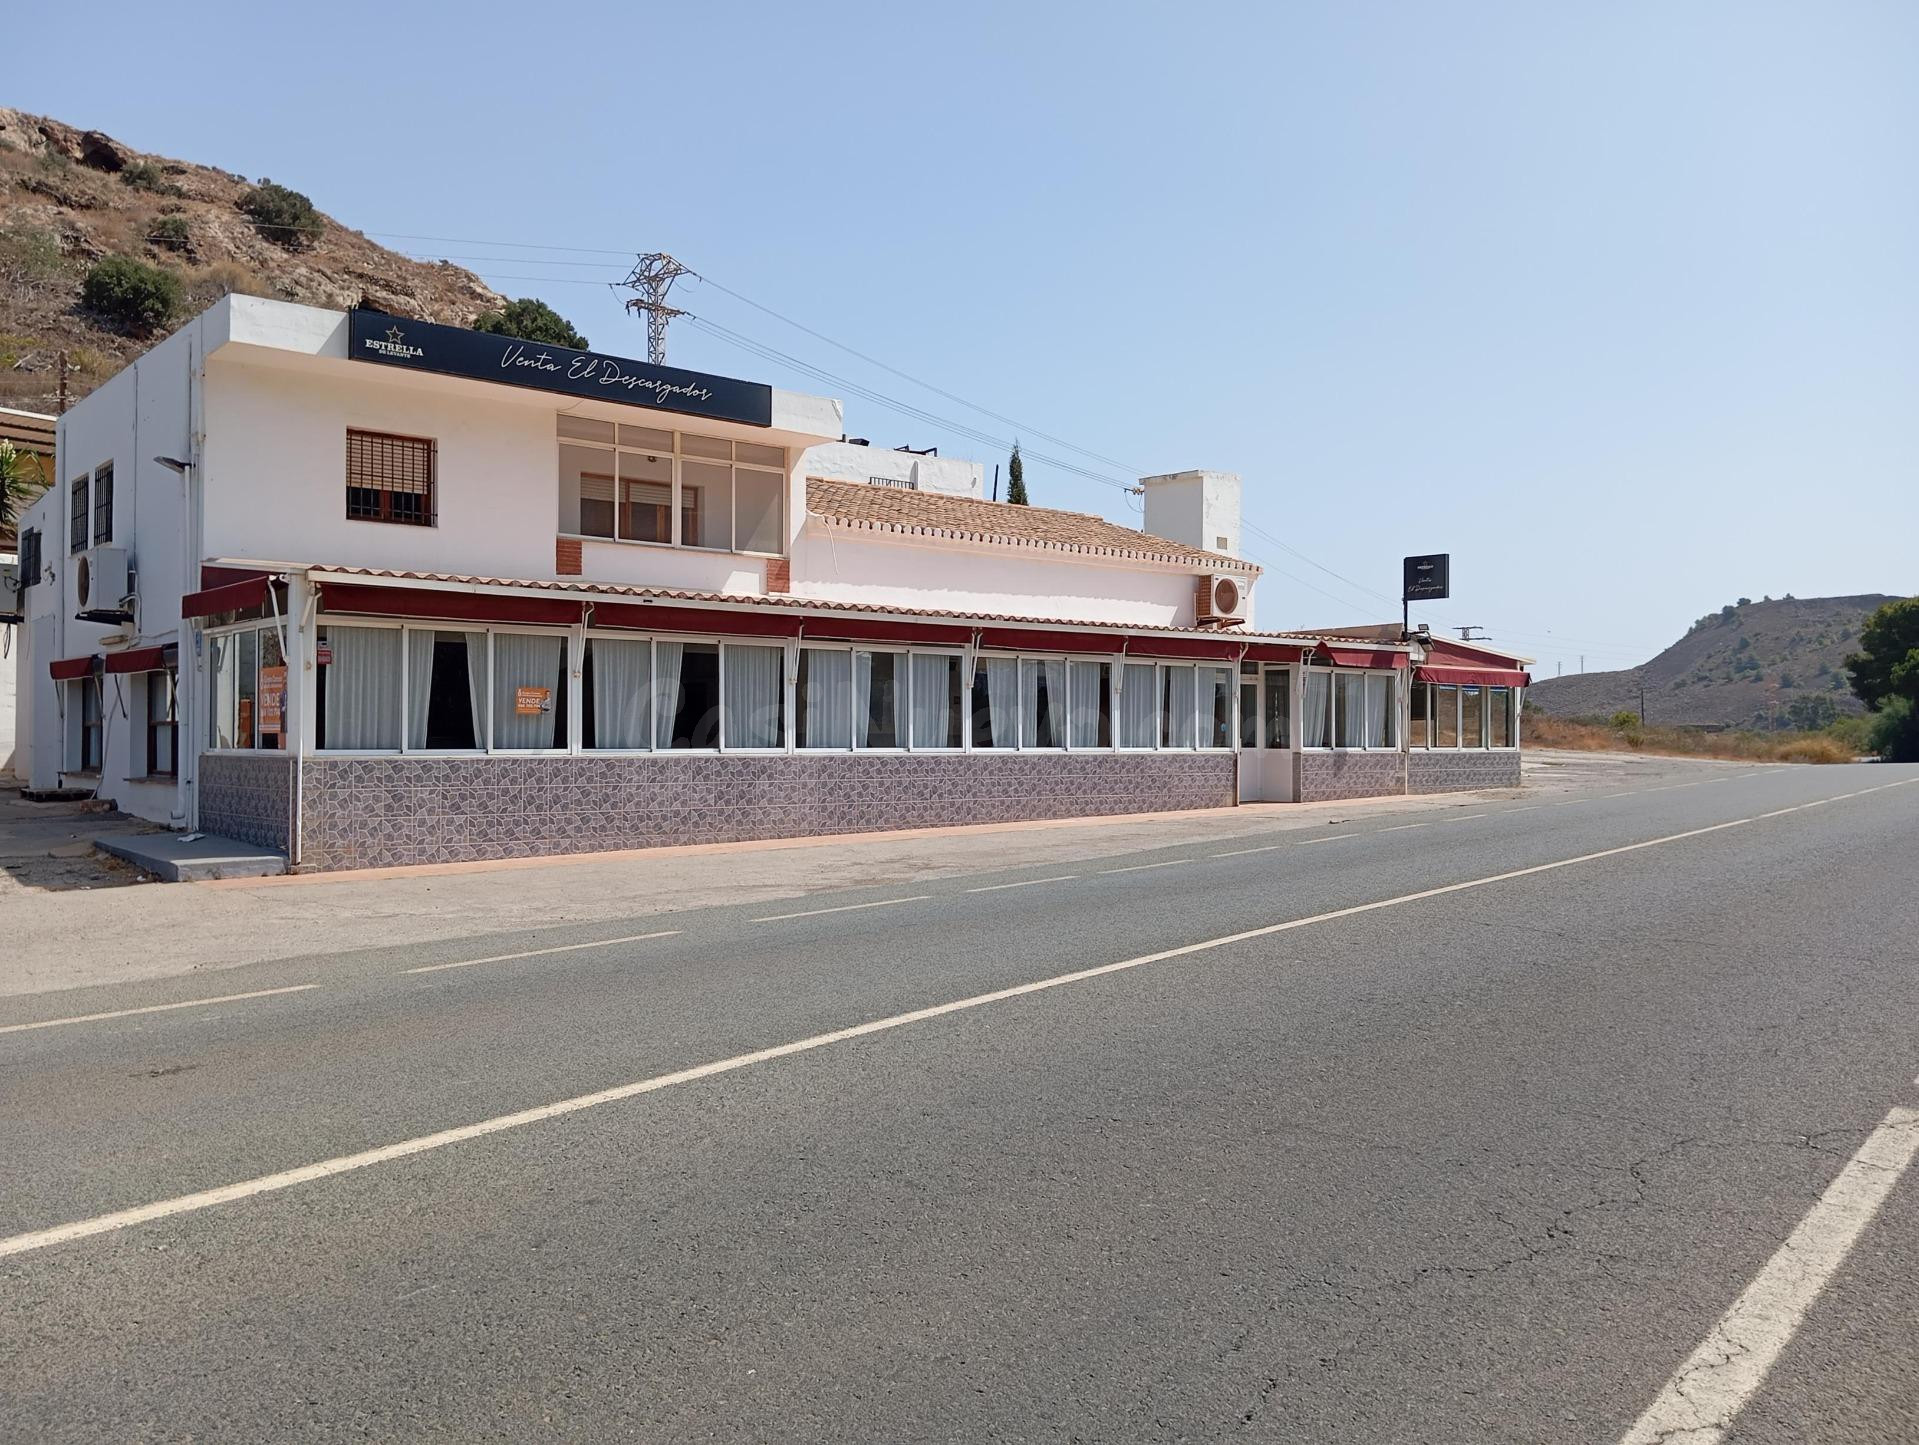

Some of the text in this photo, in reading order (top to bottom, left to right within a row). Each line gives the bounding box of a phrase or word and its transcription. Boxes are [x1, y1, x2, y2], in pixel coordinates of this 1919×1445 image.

[365, 338, 424, 357] ESTRELLA
[501, 345, 713, 403] Venta El Descargador
[518, 697, 540, 705] VENDE
